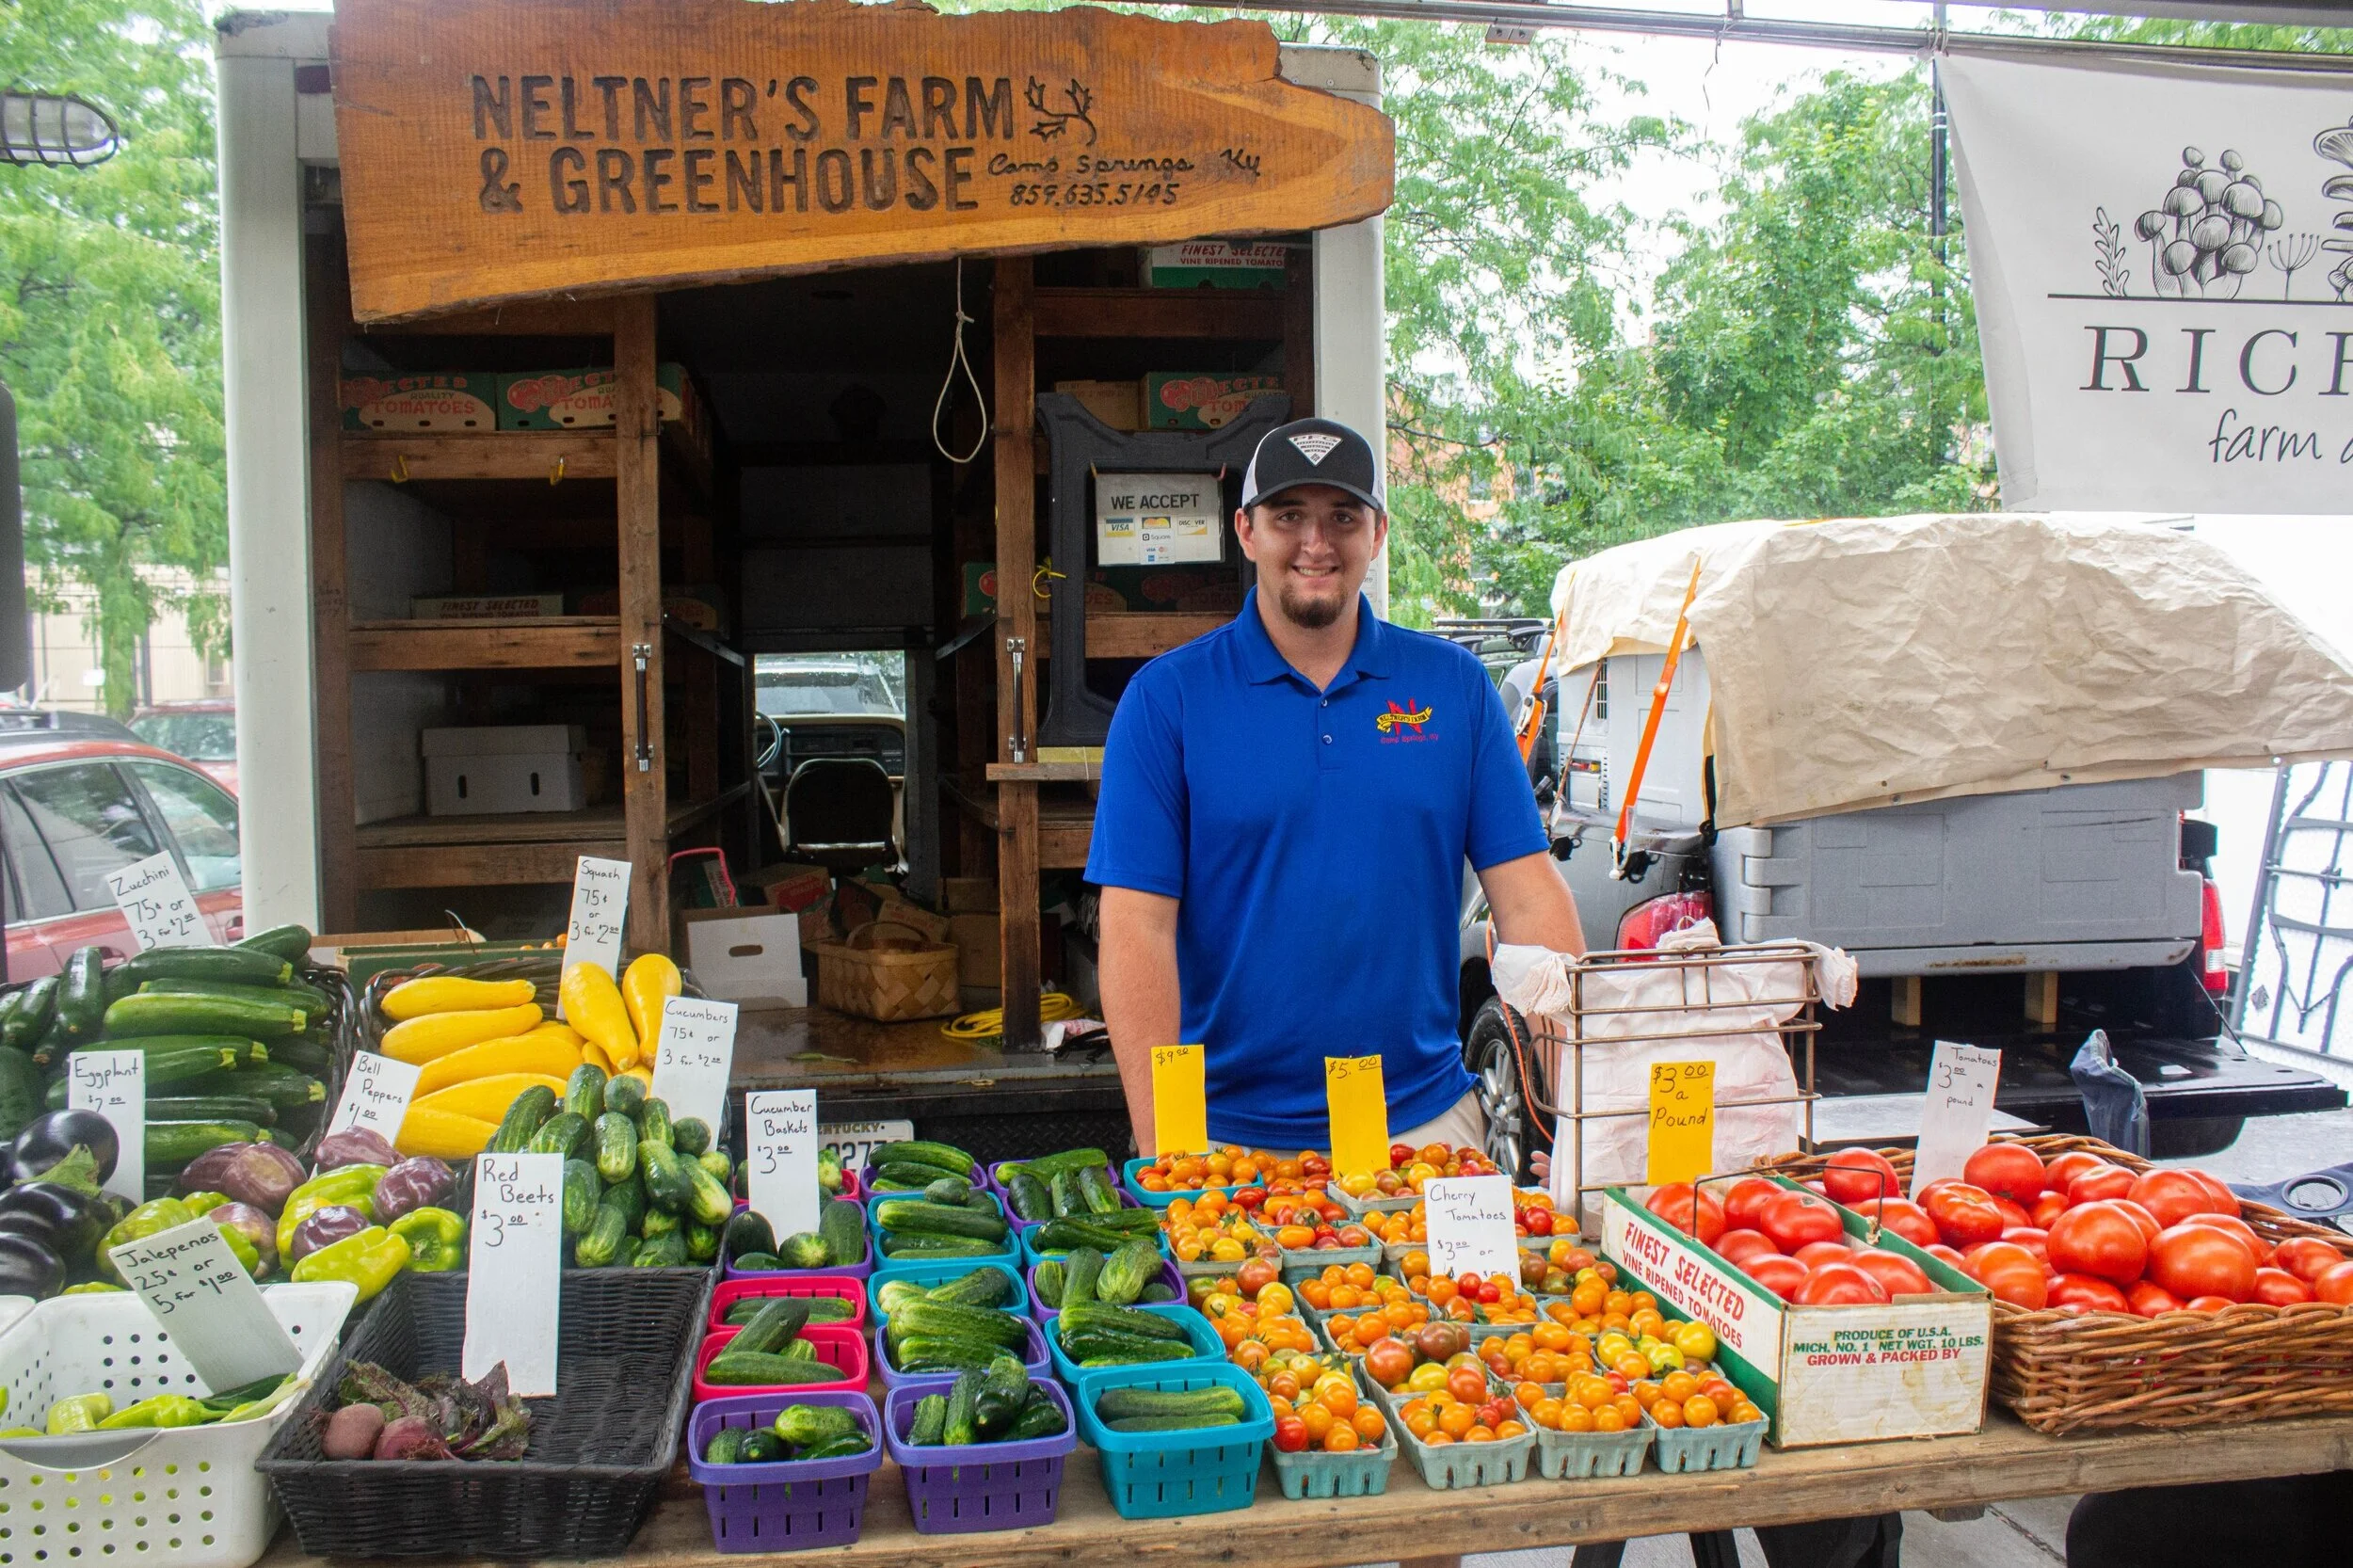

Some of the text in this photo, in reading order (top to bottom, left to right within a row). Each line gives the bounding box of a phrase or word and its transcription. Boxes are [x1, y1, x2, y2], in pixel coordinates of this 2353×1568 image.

[472, 75, 1015, 141] NELTNER'S FARM
[478, 146, 979, 215] & GREENHOUSE
[1181, 244, 1225, 257] FINEST
[1179, 257, 1286, 267] VINE RIPENED TOMATO
[373, 399, 475, 415] TOMATOES
[2209, 408, 2322, 464] farm
[1111, 493, 1200, 510] WE ACCEPT
[1111, 523, 1129, 532] VISA
[580, 859, 620, 881] Squash
[110, 865, 170, 897] Zucchini
[169, 899, 184, 911] or
[137, 929, 156, 951] 3
[568, 920, 581, 941] 3
[583, 925, 595, 936] for
[664, 999, 728, 1024] Cucumbers
[707, 1034, 720, 1043] or
[358, 1054, 381, 1076] Bell
[663, 1048, 673, 1065] 3
[680, 1054, 694, 1065] for
[1950, 1046, 1997, 1067] Tomatoes
[74, 1056, 138, 1089] Eggplant
[361, 1078, 403, 1104] Peppers
[1675, 1090, 1689, 1100] a
[750, 1095, 812, 1114] Cucumber
[1946, 1096, 1974, 1109] pound
[763, 1118, 808, 1137] Baskets
[483, 1158, 519, 1182] Red
[500, 1183, 554, 1204] Beets
[1430, 1183, 1476, 1207] Cherry
[1445, 1208, 1507, 1222] Tomatoes
[116, 1232, 219, 1268] Jalepenos
[1479, 1248, 1495, 1256] or
[193, 1258, 216, 1272] or
[1625, 1221, 1745, 1321] FINEST SELECTED
[151, 1293, 176, 1314] 5
[175, 1290, 196, 1301] for
[1622, 1249, 1742, 1350] VINE RIPENED TOMATOES
[1792, 1335, 1985, 1353] MICH. NO. 1 NET WGT. 10 LBS.
[1833, 1326, 1952, 1341] PRODUCE OF U.S.A.
[1806, 1348, 1961, 1366] GROWN & PACKED BY
